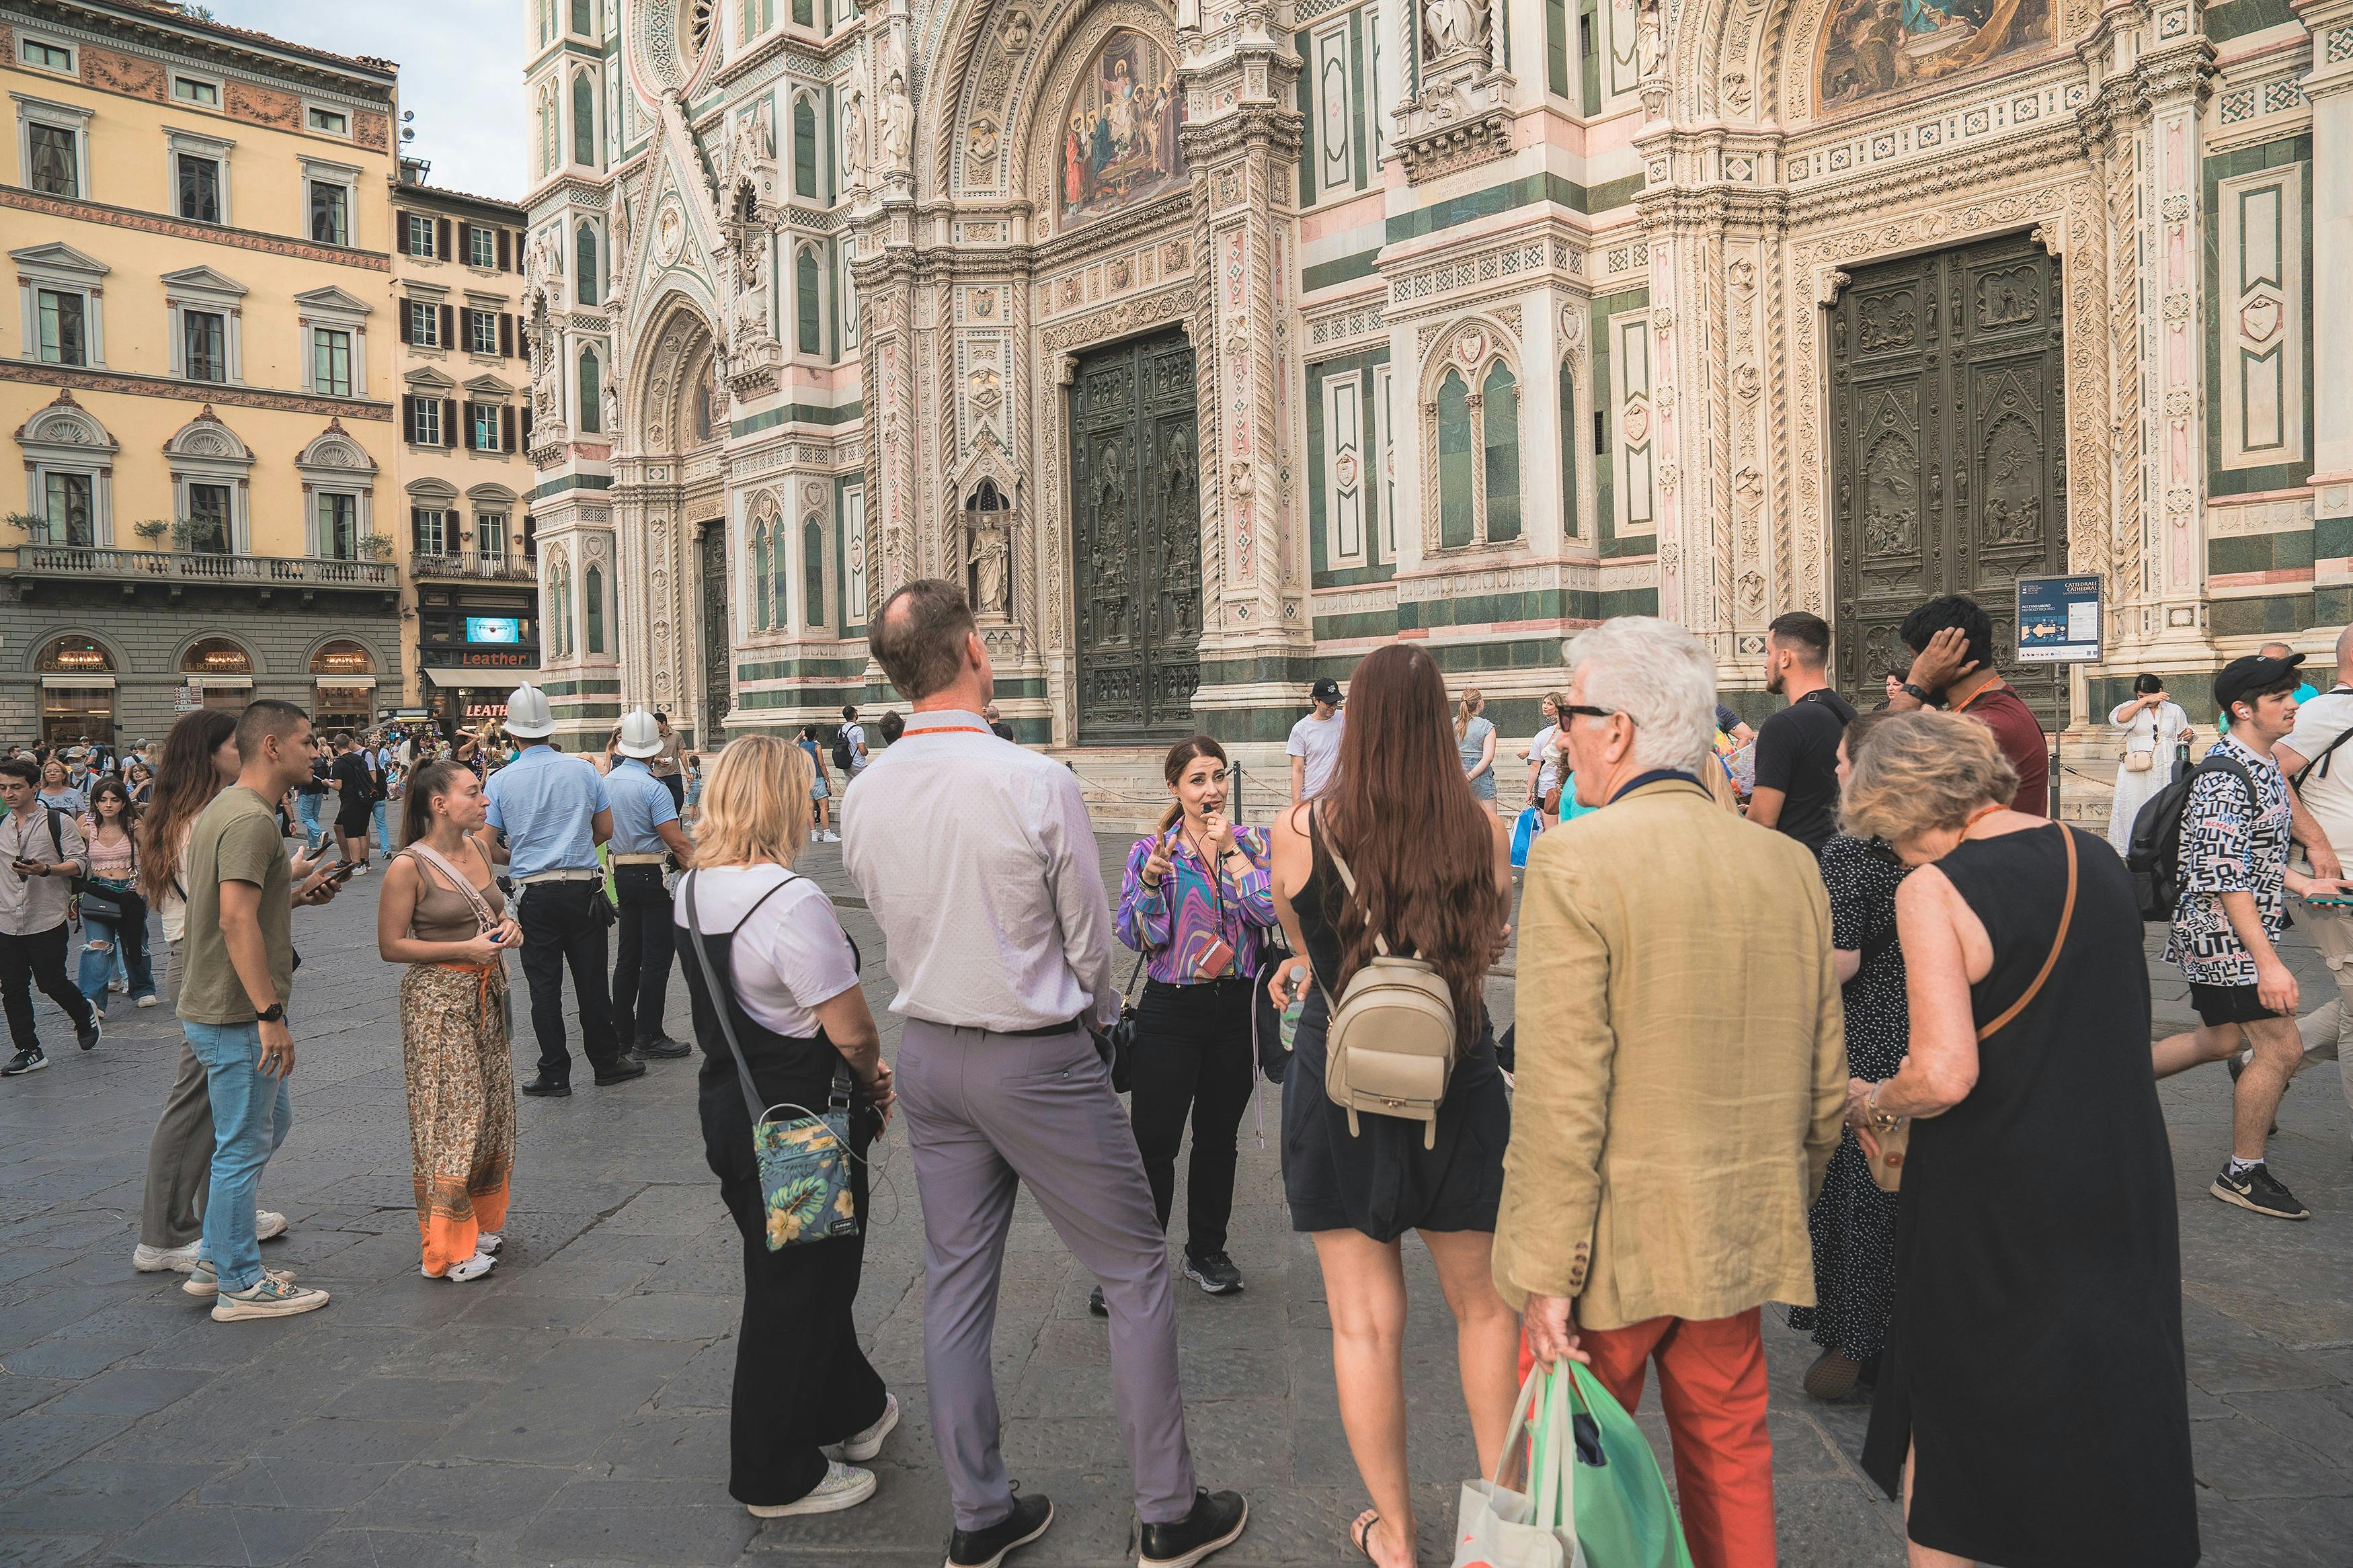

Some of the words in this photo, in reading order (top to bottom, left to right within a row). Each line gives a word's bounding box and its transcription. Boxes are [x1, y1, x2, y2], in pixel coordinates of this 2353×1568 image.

[463, 652, 527, 665] Leather
[43, 661, 108, 670] CAFFETTERIA
[196, 662, 248, 670] BOTTEGONE
[466, 704, 508, 716] LEATH
